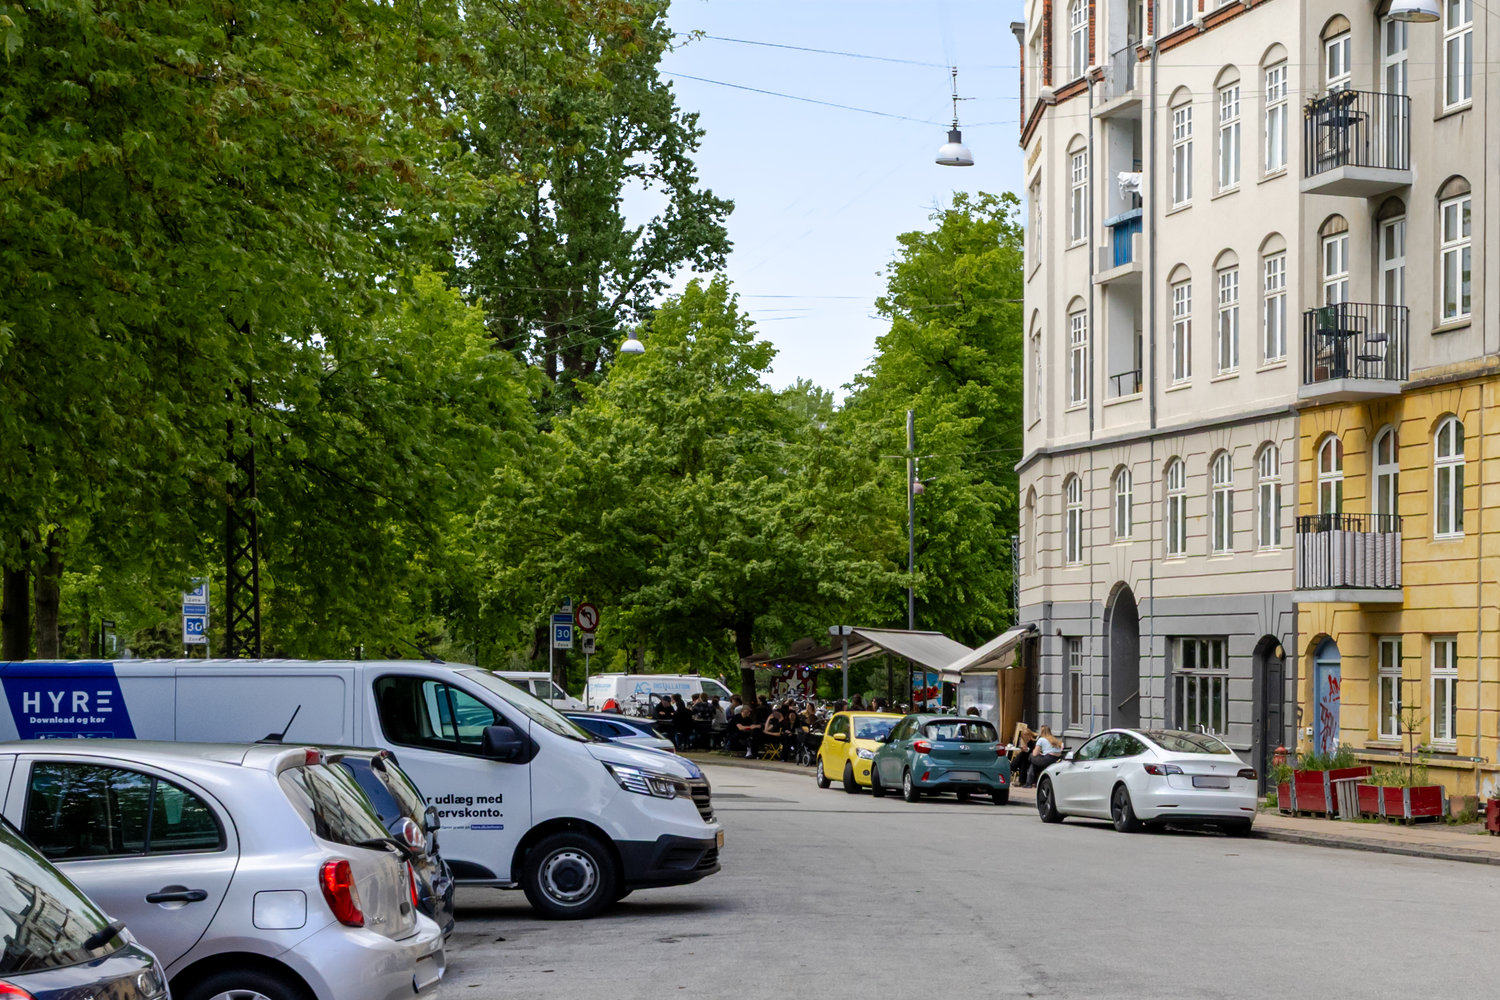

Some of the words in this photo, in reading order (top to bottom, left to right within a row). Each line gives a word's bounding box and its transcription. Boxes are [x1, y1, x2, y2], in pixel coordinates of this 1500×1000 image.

[187, 621, 203, 632] 30
[556, 629, 570, 639] 30
[23, 690, 113, 713] HYRE
[29, 716, 75, 724] Download
[76, 717, 88, 725] og
[435, 794, 473, 806] udlæg
[476, 793, 503, 804] med
